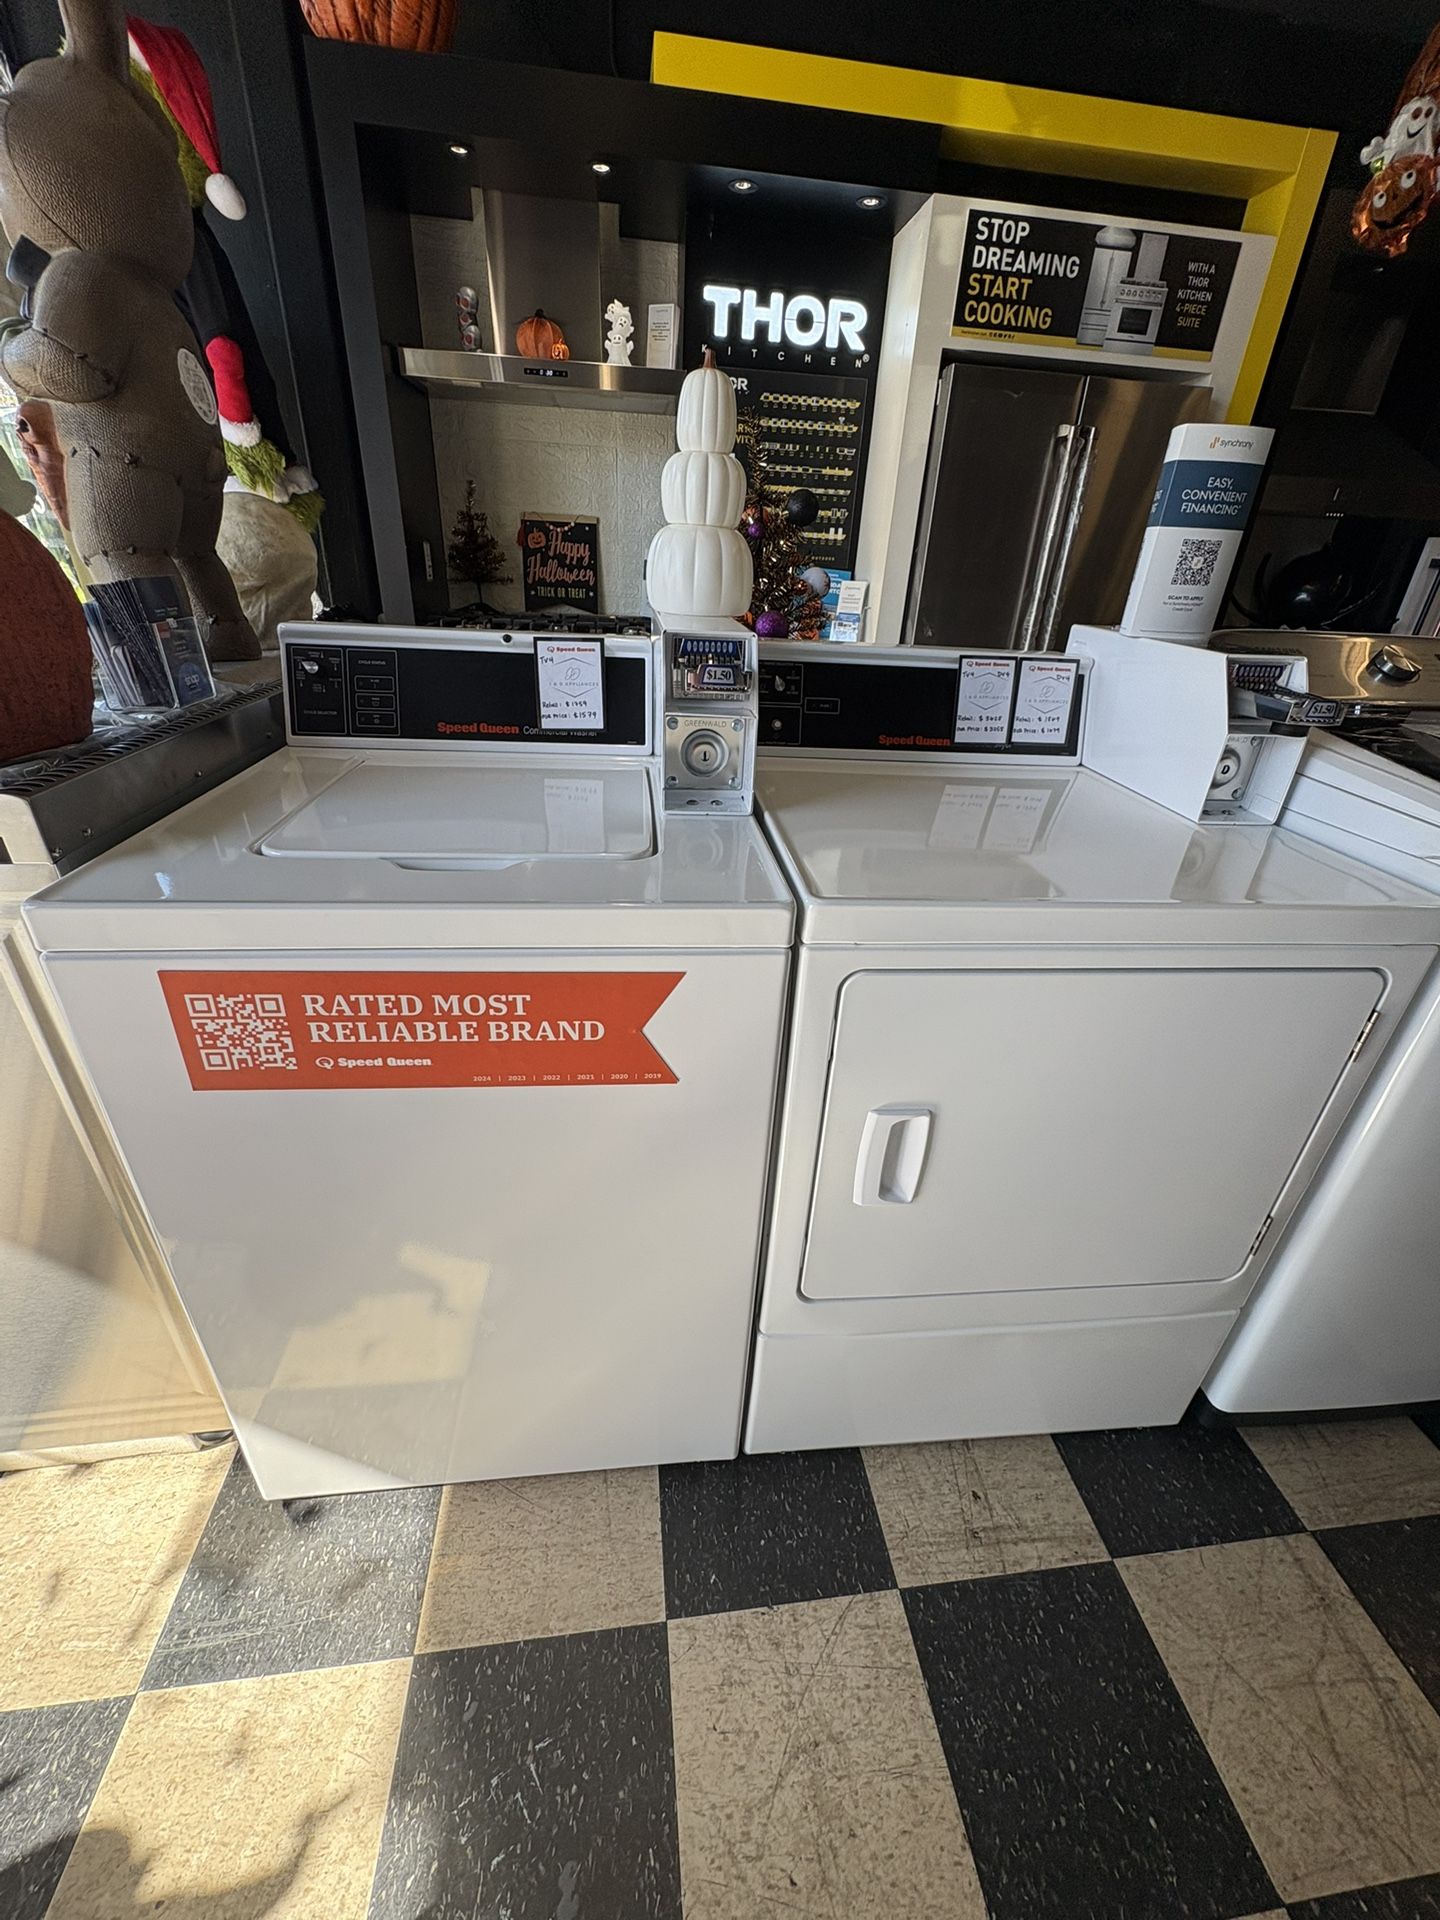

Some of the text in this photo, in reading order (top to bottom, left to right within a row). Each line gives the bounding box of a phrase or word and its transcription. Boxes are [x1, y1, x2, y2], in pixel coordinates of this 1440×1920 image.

[975, 216, 1030, 246] STOP
[972, 245, 1080, 279] DREAMING
[1188, 261, 1216, 275] WITH A
[967, 273, 1033, 301] START
[1187, 275, 1210, 288] THOR
[1177, 289, 1213, 302] KITCHEN
[964, 300, 1052, 330] COOKING
[1175, 303, 1207, 316] 4-PIECE
[703, 284, 868, 351] THOR
[1177, 316, 1201, 328] SUITE
[1220, 438, 1254, 448] synchrony
[1207, 476, 1234, 490] EASY,
[1181, 489, 1248, 502] CONVENIENT
[548, 530, 590, 566] Happy
[527, 553, 595, 586] Halloween
[537, 586, 586, 599] TRICK OR TREAT
[706, 668, 732, 682] $1.50
[437, 722, 478, 734] Speed
[480, 722, 519, 734] Queen
[684, 720, 727, 728] GREENWALD
[878, 734, 950, 746] Speed Queen
[301, 994, 531, 1016] RATED MOST
[307, 1020, 605, 1043] RELIABLE BRAND
[337, 1057, 432, 1068] Speed Queen
